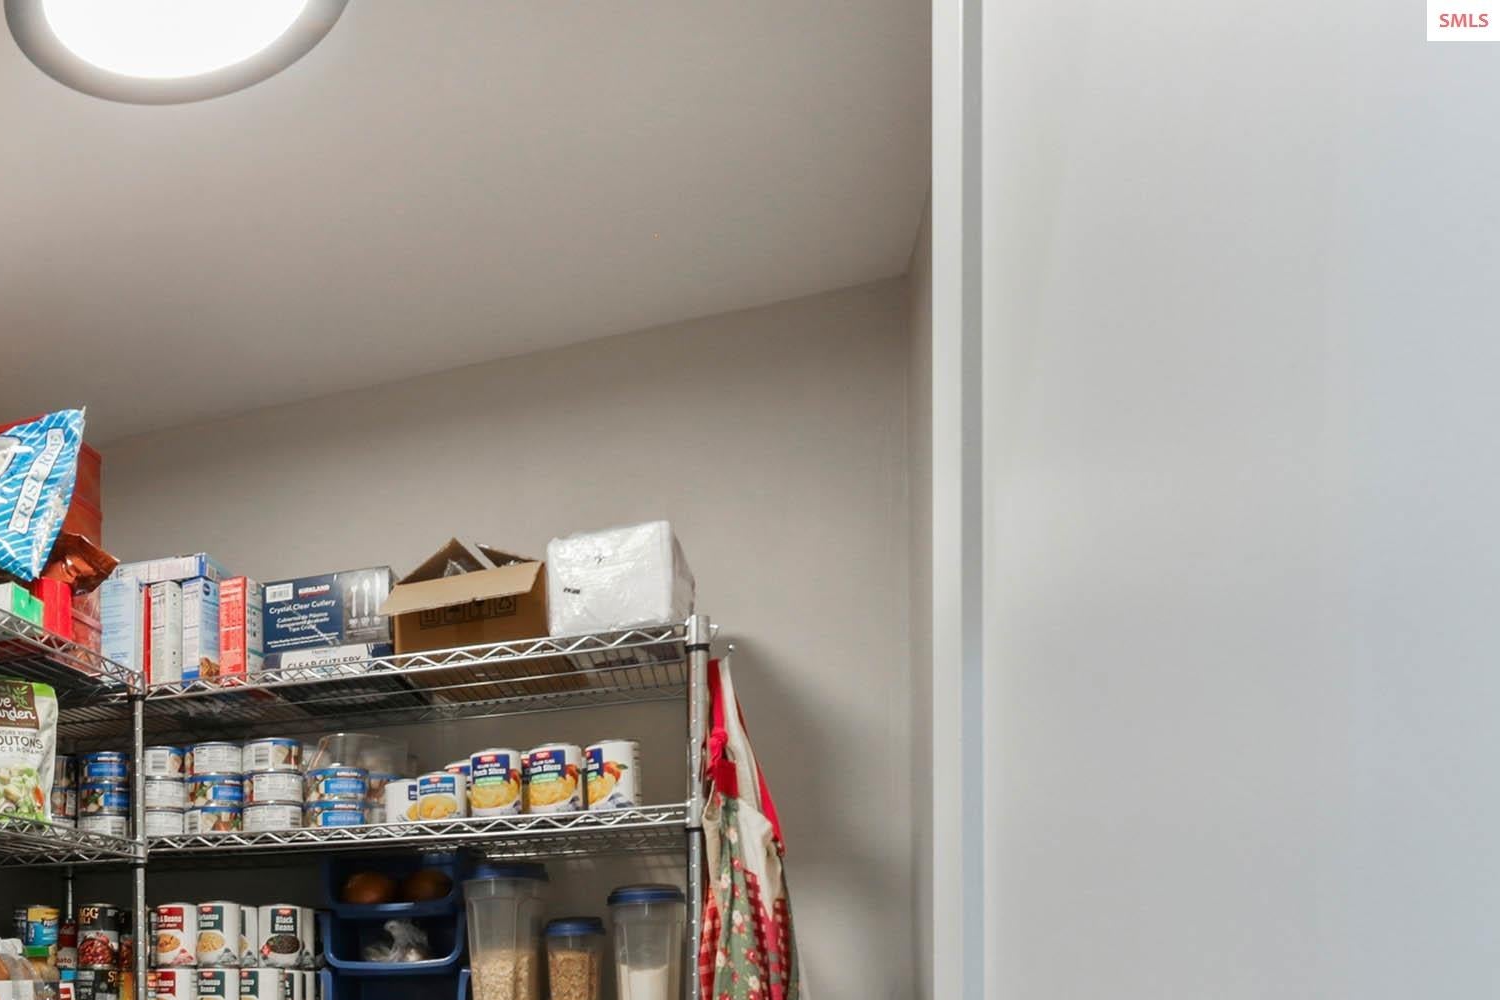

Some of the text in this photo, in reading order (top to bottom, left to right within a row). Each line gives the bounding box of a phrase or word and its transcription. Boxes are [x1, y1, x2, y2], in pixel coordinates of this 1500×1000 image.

[269, 603, 292, 615] Crystal
[311, 599, 336, 609] Cutlery
[275, 915, 294, 924] Black
[274, 924, 295, 932] Beans
